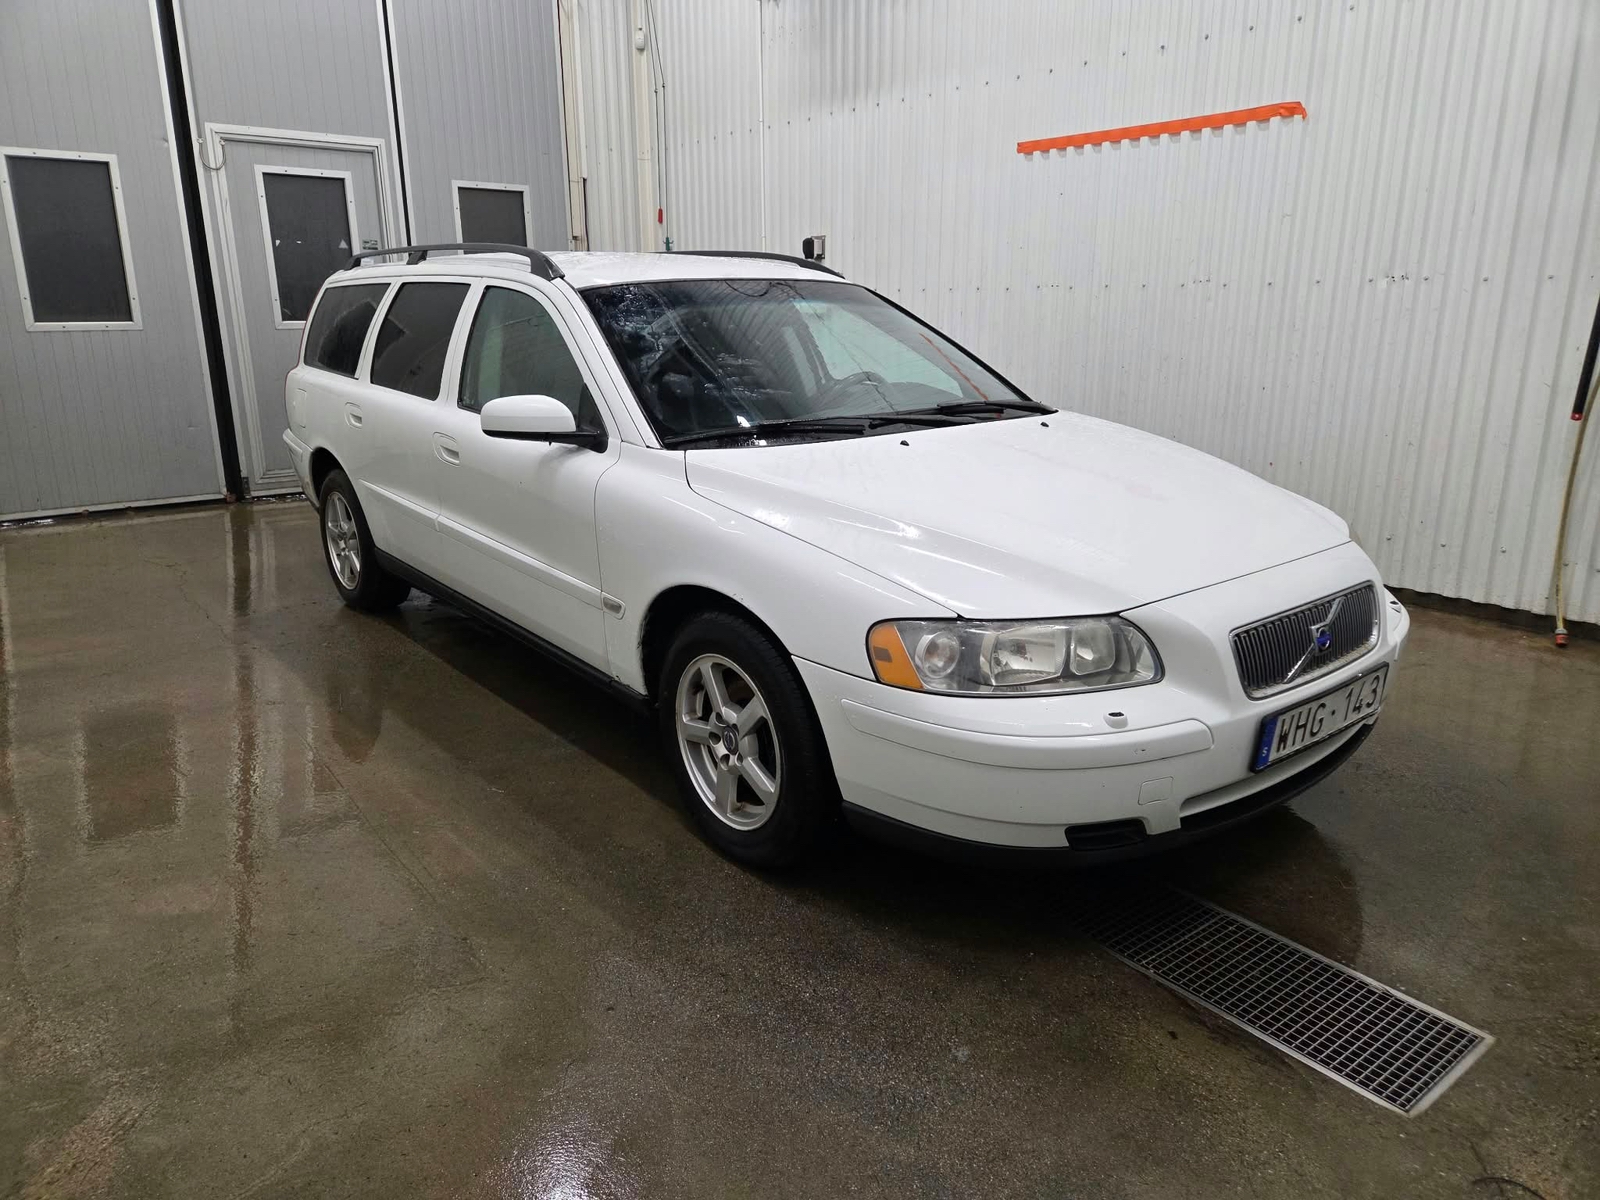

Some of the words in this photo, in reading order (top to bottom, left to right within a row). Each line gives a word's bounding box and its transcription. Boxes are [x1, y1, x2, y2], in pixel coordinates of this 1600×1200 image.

[1276, 702, 1326, 753] WHG
[1344, 674, 1380, 722] 143
[1261, 746, 1268, 757] S
